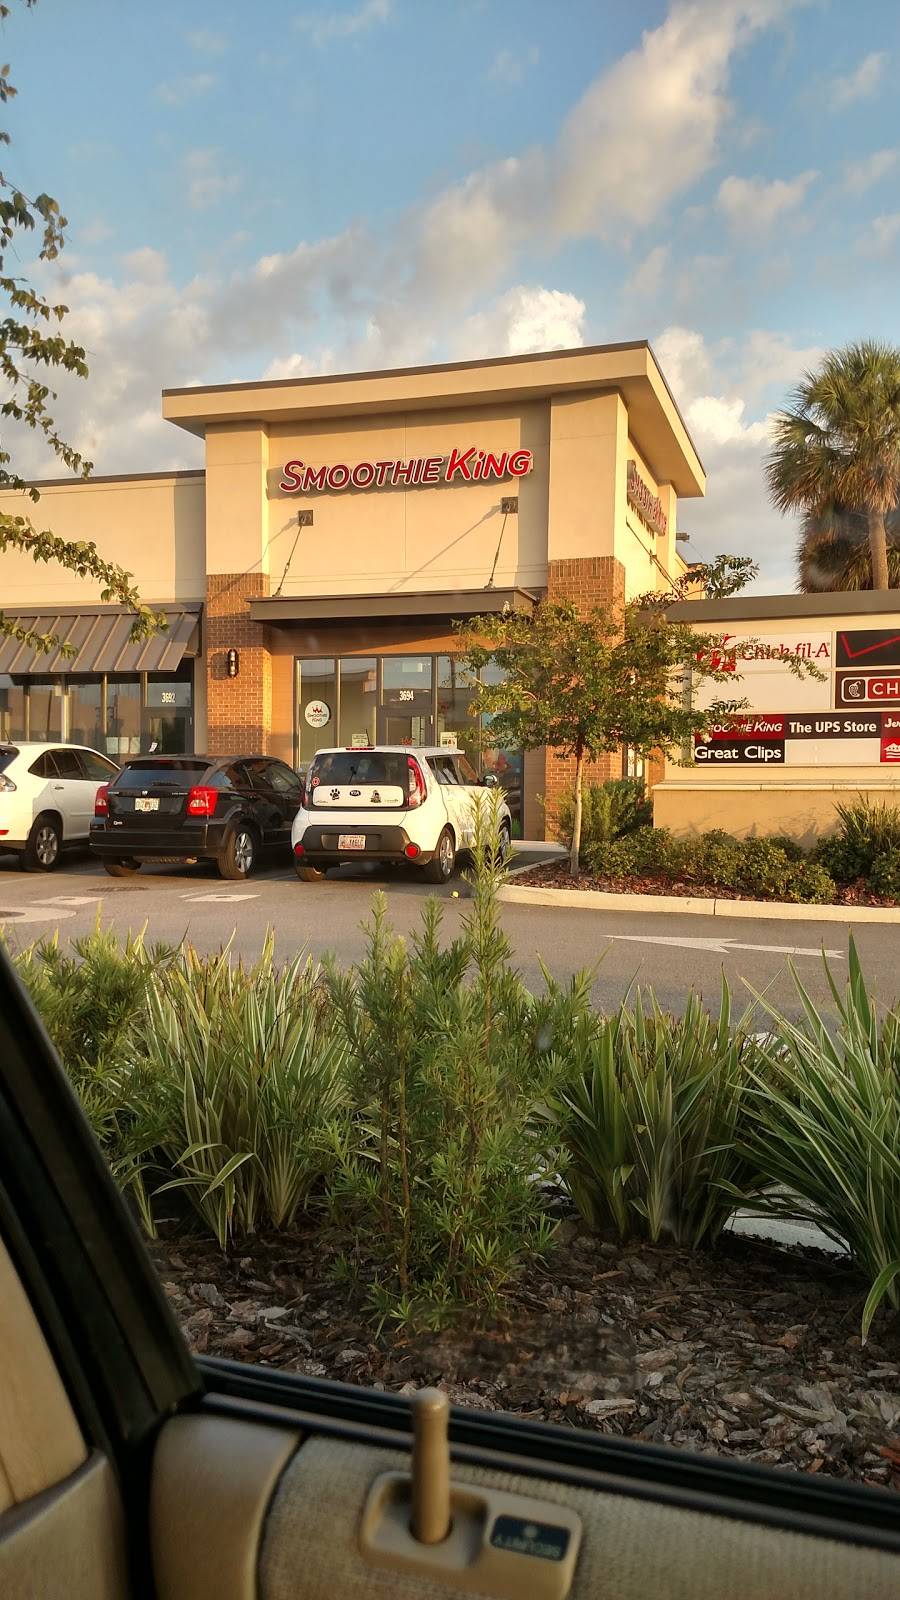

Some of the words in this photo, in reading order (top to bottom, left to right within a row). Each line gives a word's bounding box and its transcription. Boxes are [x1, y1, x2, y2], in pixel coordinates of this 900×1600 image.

[280, 457, 444, 493] SMOOTHIE
[872, 682, 900, 695] CH
[399, 690, 414, 701] 3694
[789, 721, 812, 733] The
[815, 721, 840, 733] UPS
[844, 720, 877, 733] Store
[694, 745, 739, 760] Great
[744, 745, 782, 761] Clips
